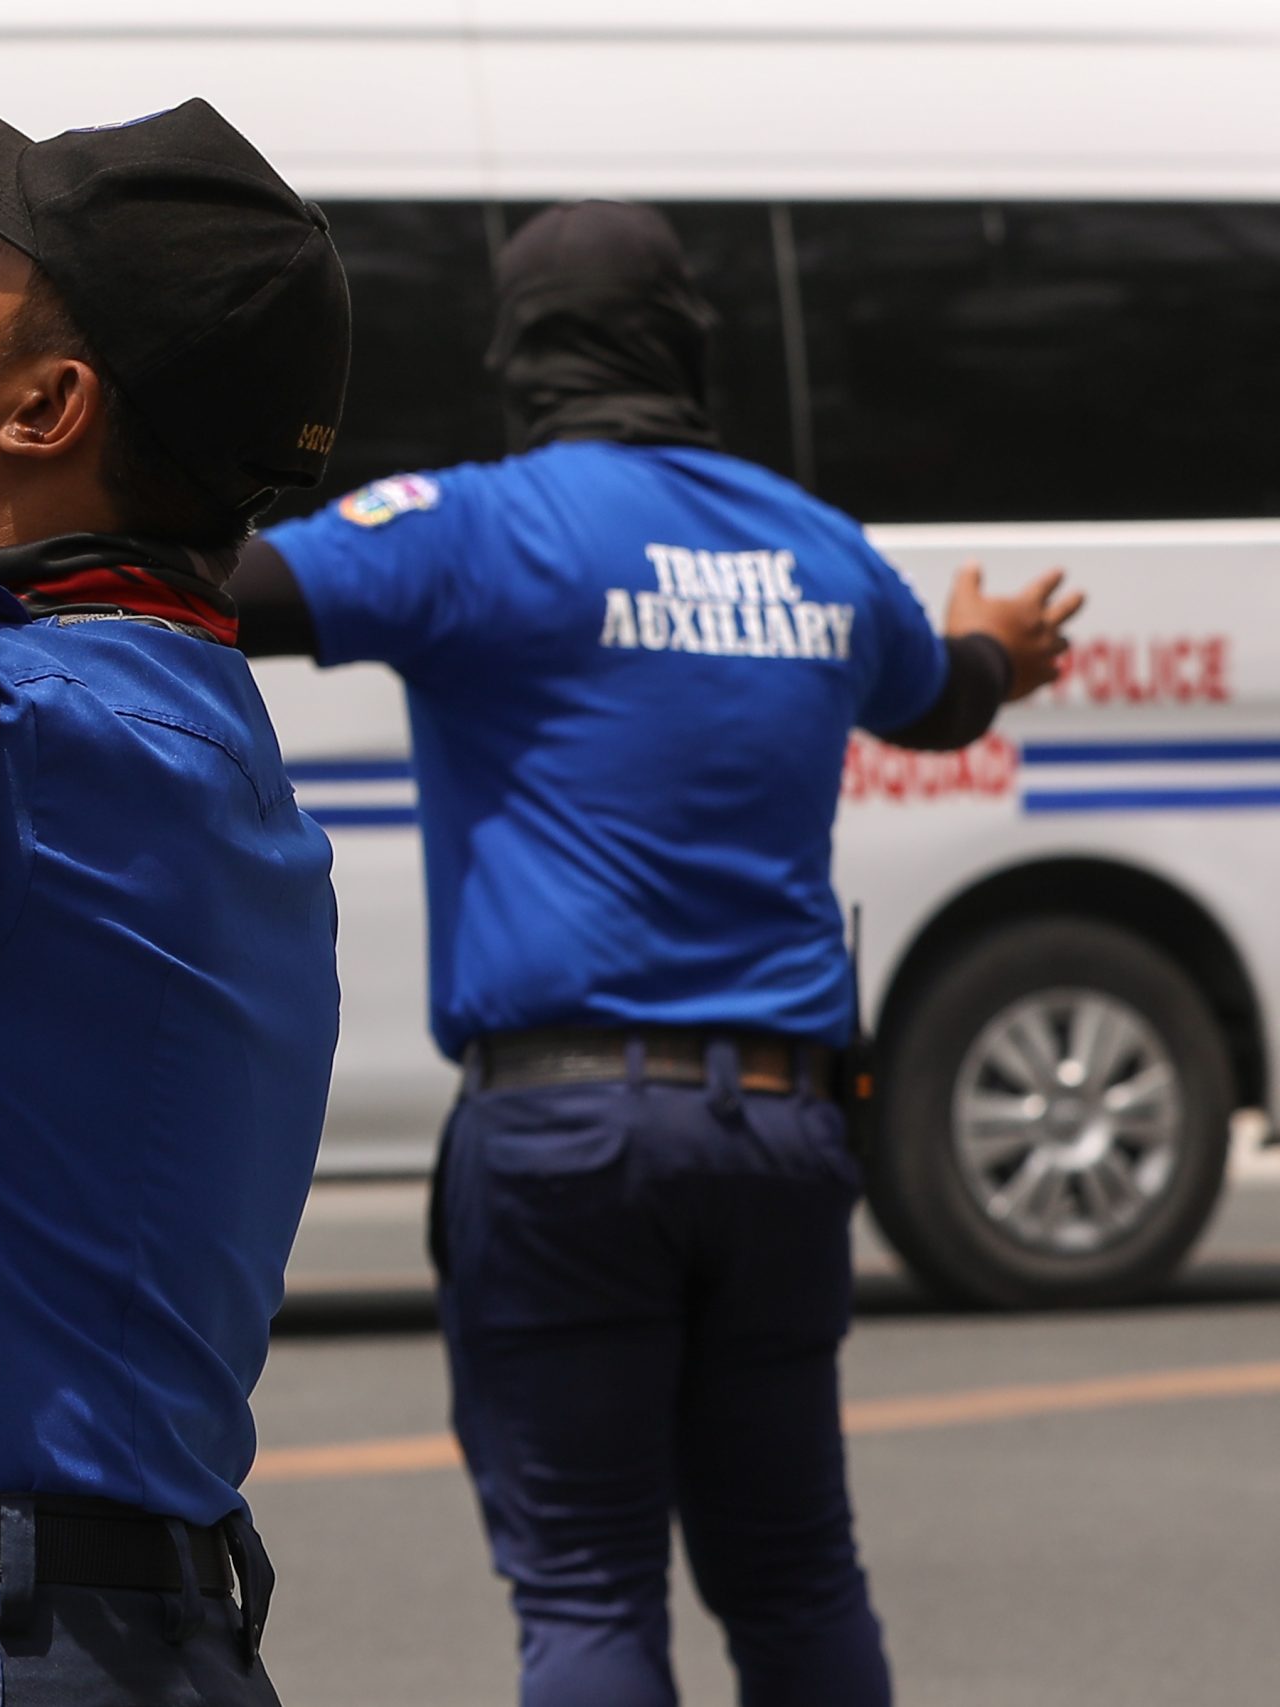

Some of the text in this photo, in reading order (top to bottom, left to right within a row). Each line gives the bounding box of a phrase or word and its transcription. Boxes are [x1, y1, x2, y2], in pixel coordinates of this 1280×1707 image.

[645, 543, 802, 602] TRAFFIC
[600, 588, 854, 659] AUXILIARY
[1053, 636, 1232, 705] POLICE
[843, 735, 1018, 798] SQUAD
